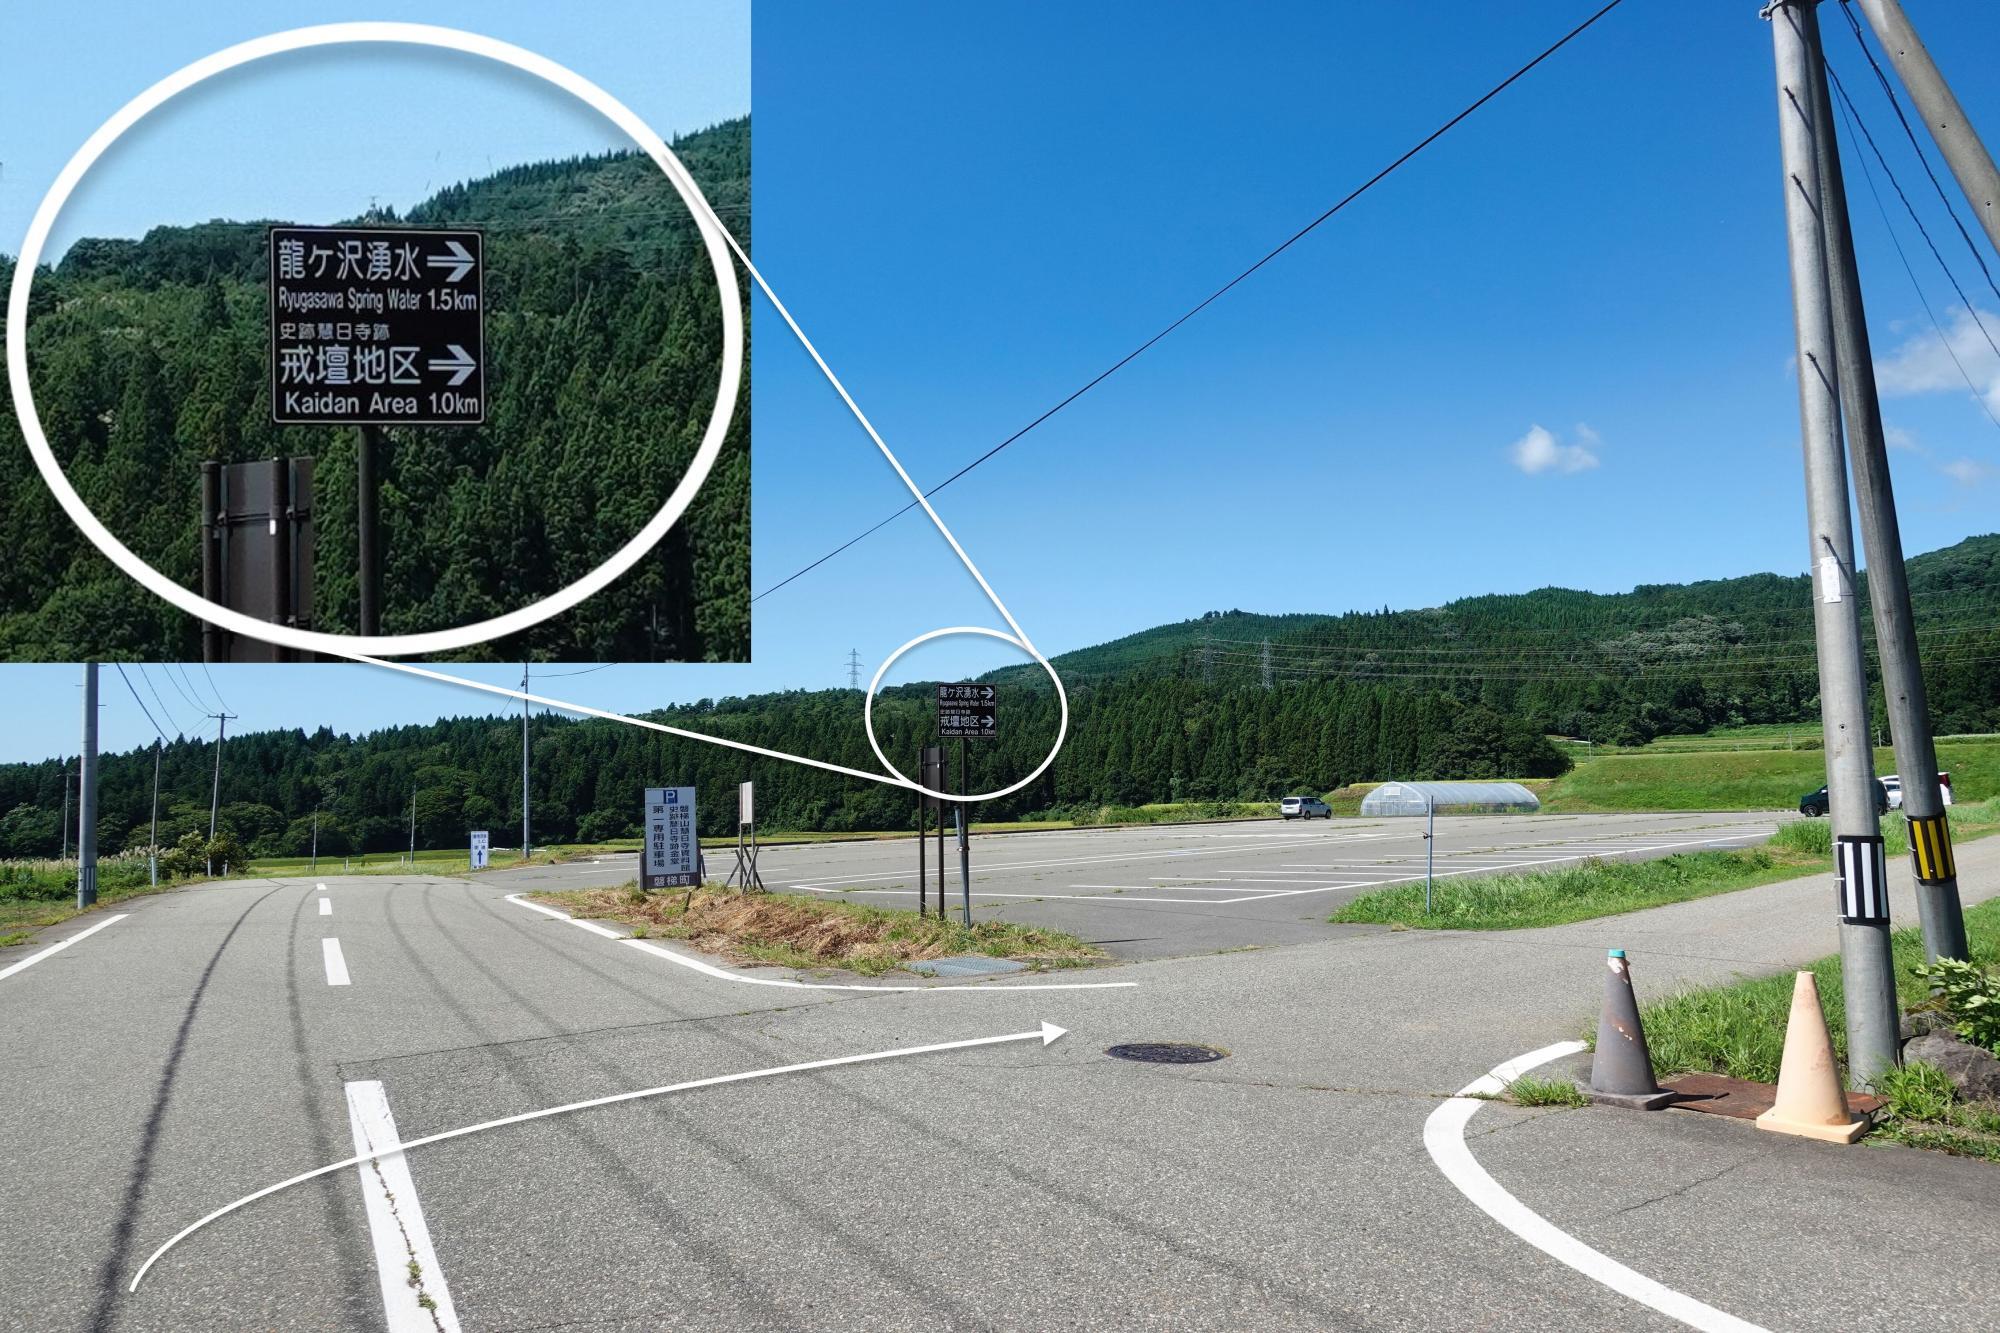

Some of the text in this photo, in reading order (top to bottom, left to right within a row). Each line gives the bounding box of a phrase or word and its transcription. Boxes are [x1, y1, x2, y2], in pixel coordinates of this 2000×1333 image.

[278, 239, 421, 281] 龍ケ沢湧水
[279, 286, 477, 314] Ryugasawa Spring Water 1.5km
[280, 322, 390, 341] 史跡慧日寺跡
[280, 344, 422, 384] 戒壇地区
[285, 391, 360, 414] Kaidan
[369, 392, 418, 414] Area
[666, 791, 675, 803] P
